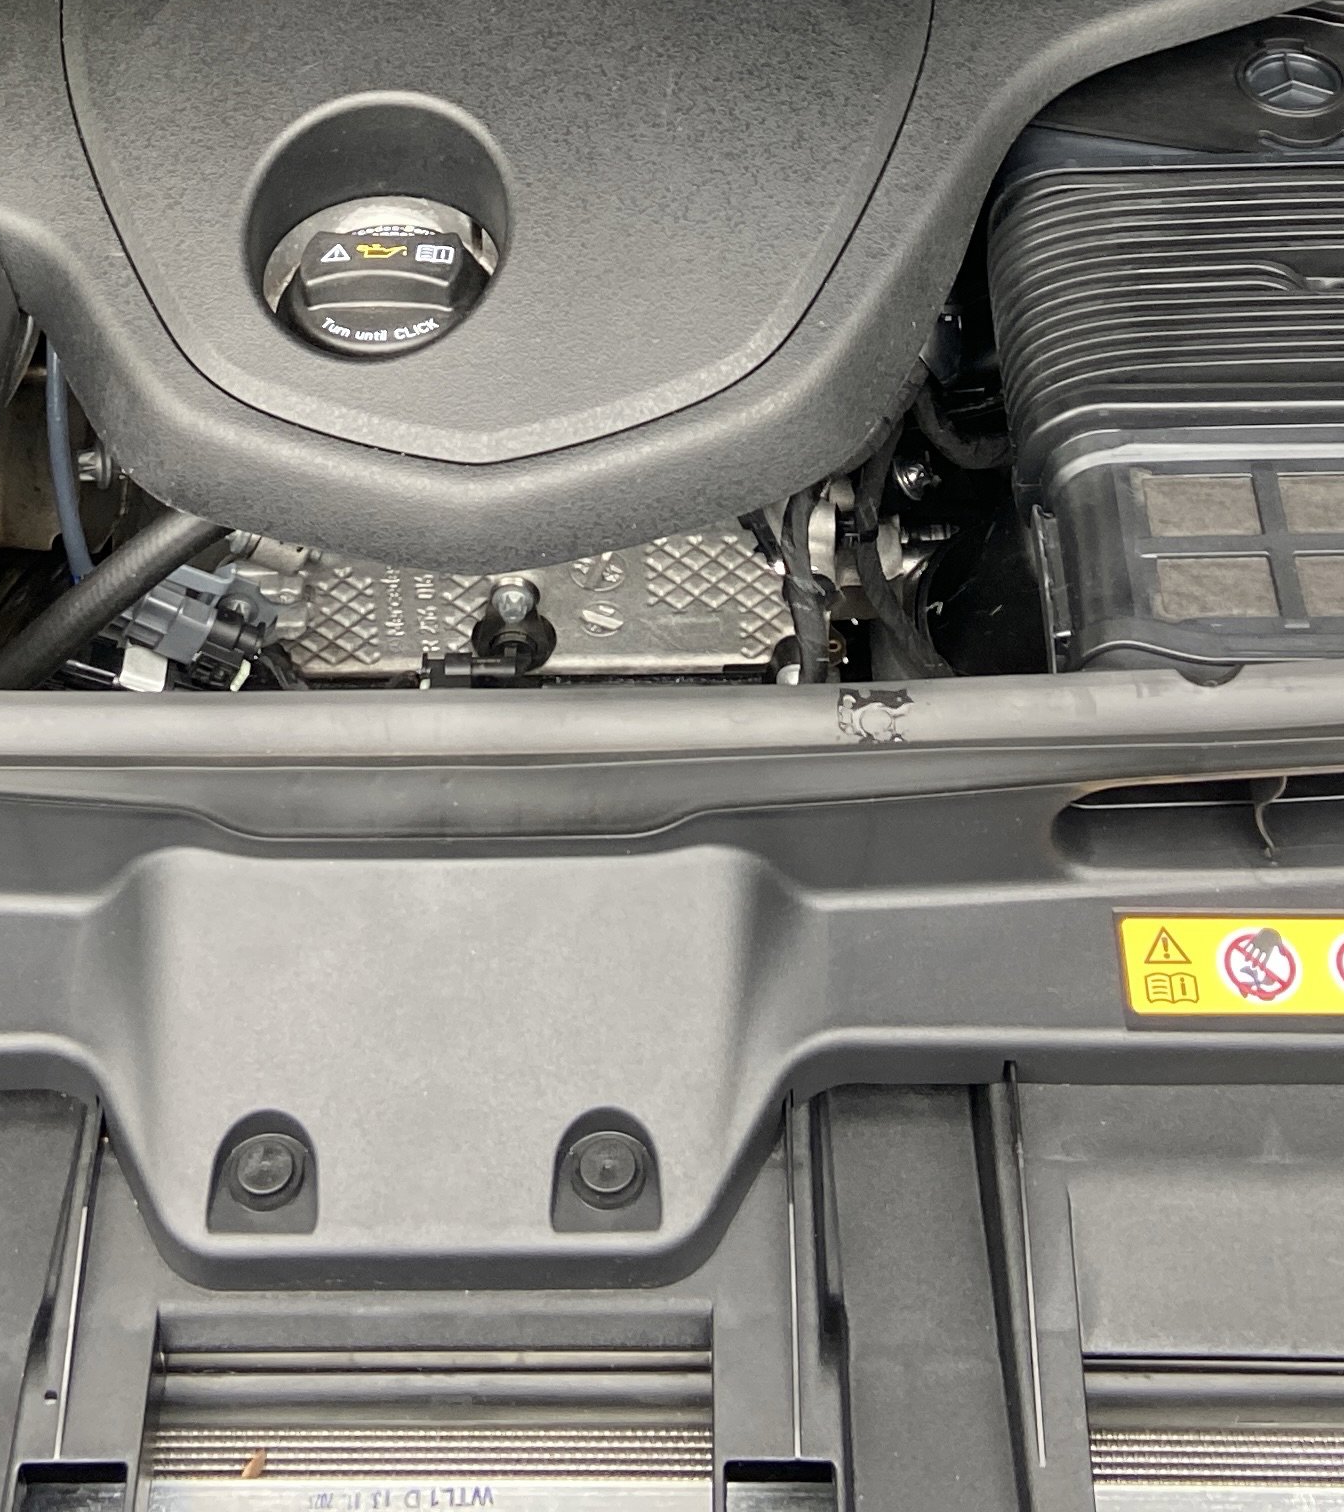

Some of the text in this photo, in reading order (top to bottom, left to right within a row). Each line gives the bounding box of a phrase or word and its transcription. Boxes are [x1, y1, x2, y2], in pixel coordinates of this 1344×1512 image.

[322, 317, 440, 341] Turn until CLICK
